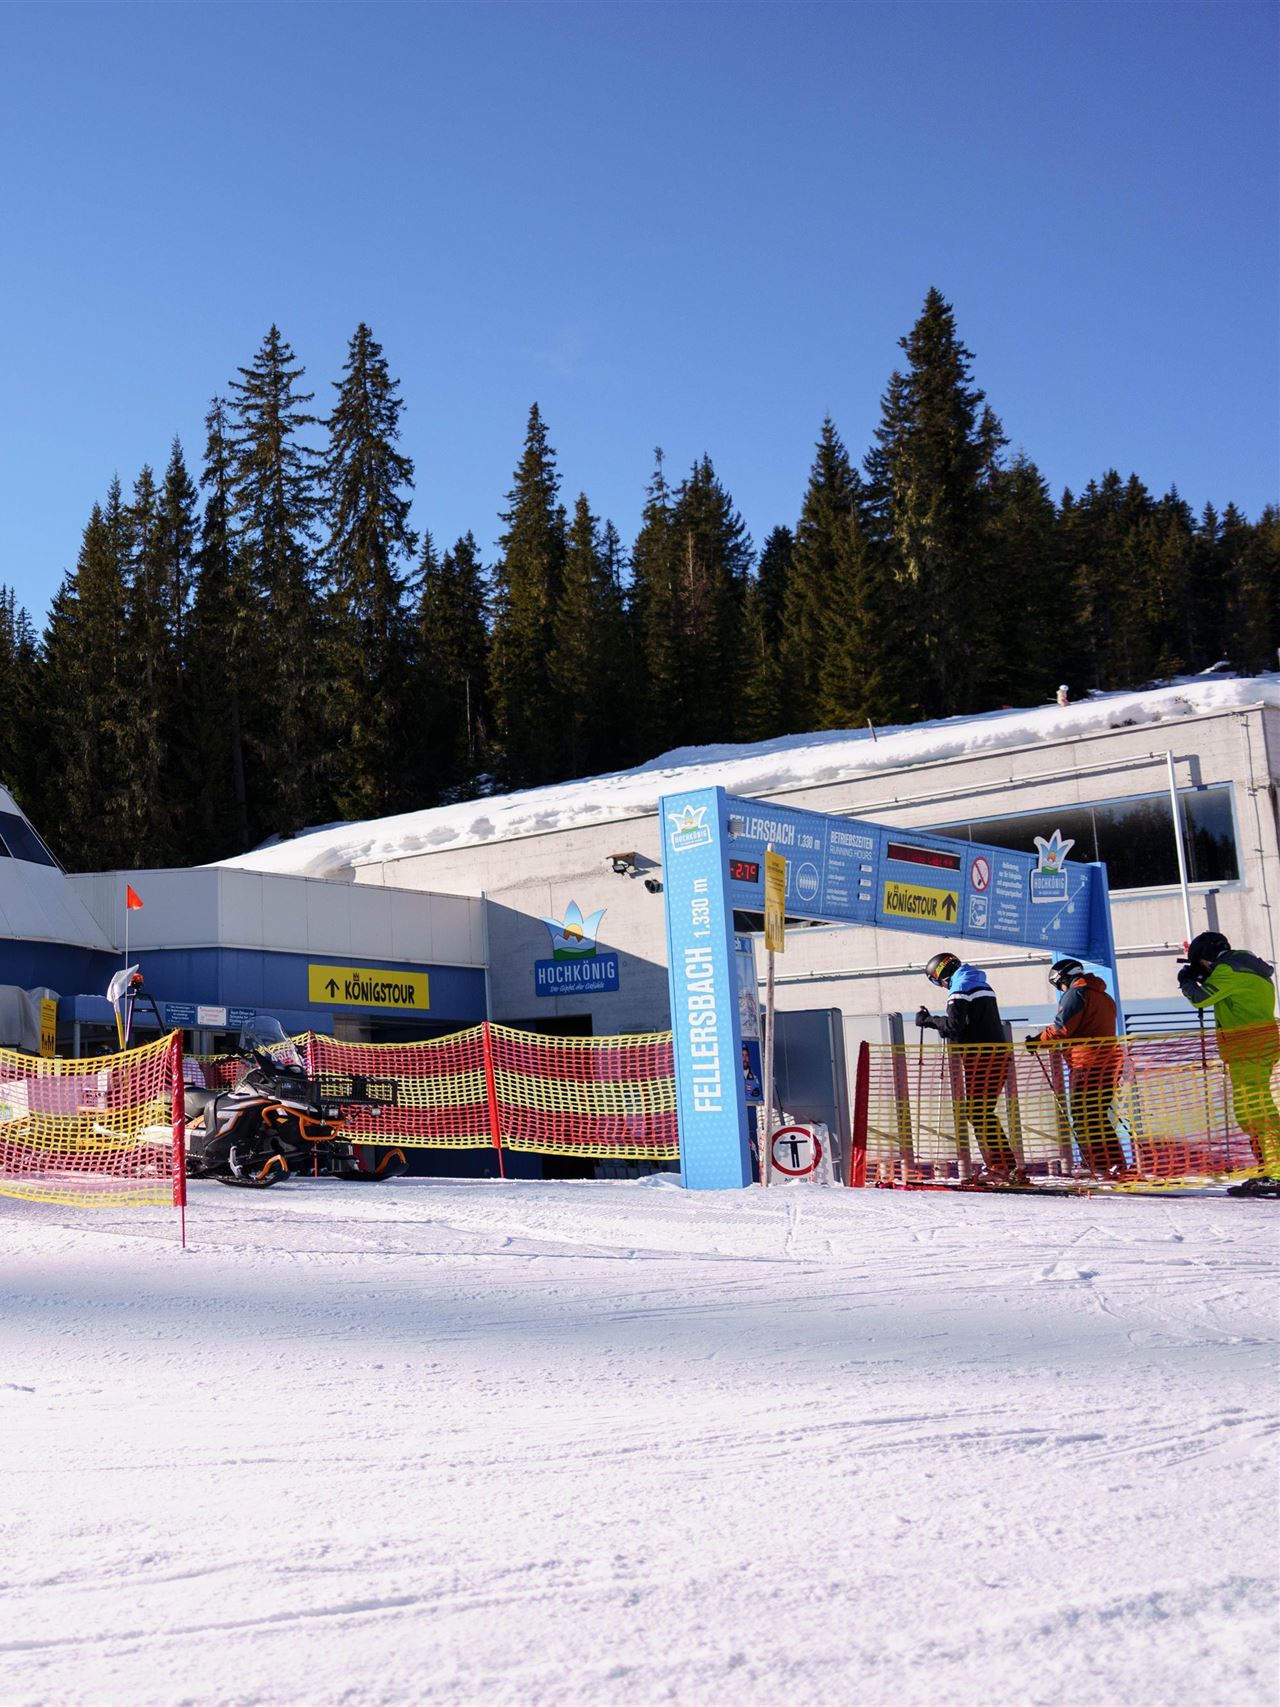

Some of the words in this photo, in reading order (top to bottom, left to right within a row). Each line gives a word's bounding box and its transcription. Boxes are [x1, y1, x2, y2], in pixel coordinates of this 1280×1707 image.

[694, 878, 708, 892] m
[691, 898, 711, 938] 1.330
[538, 960, 615, 984] HOCHKÖNIG
[685, 947, 722, 1112] FELLERSBACH
